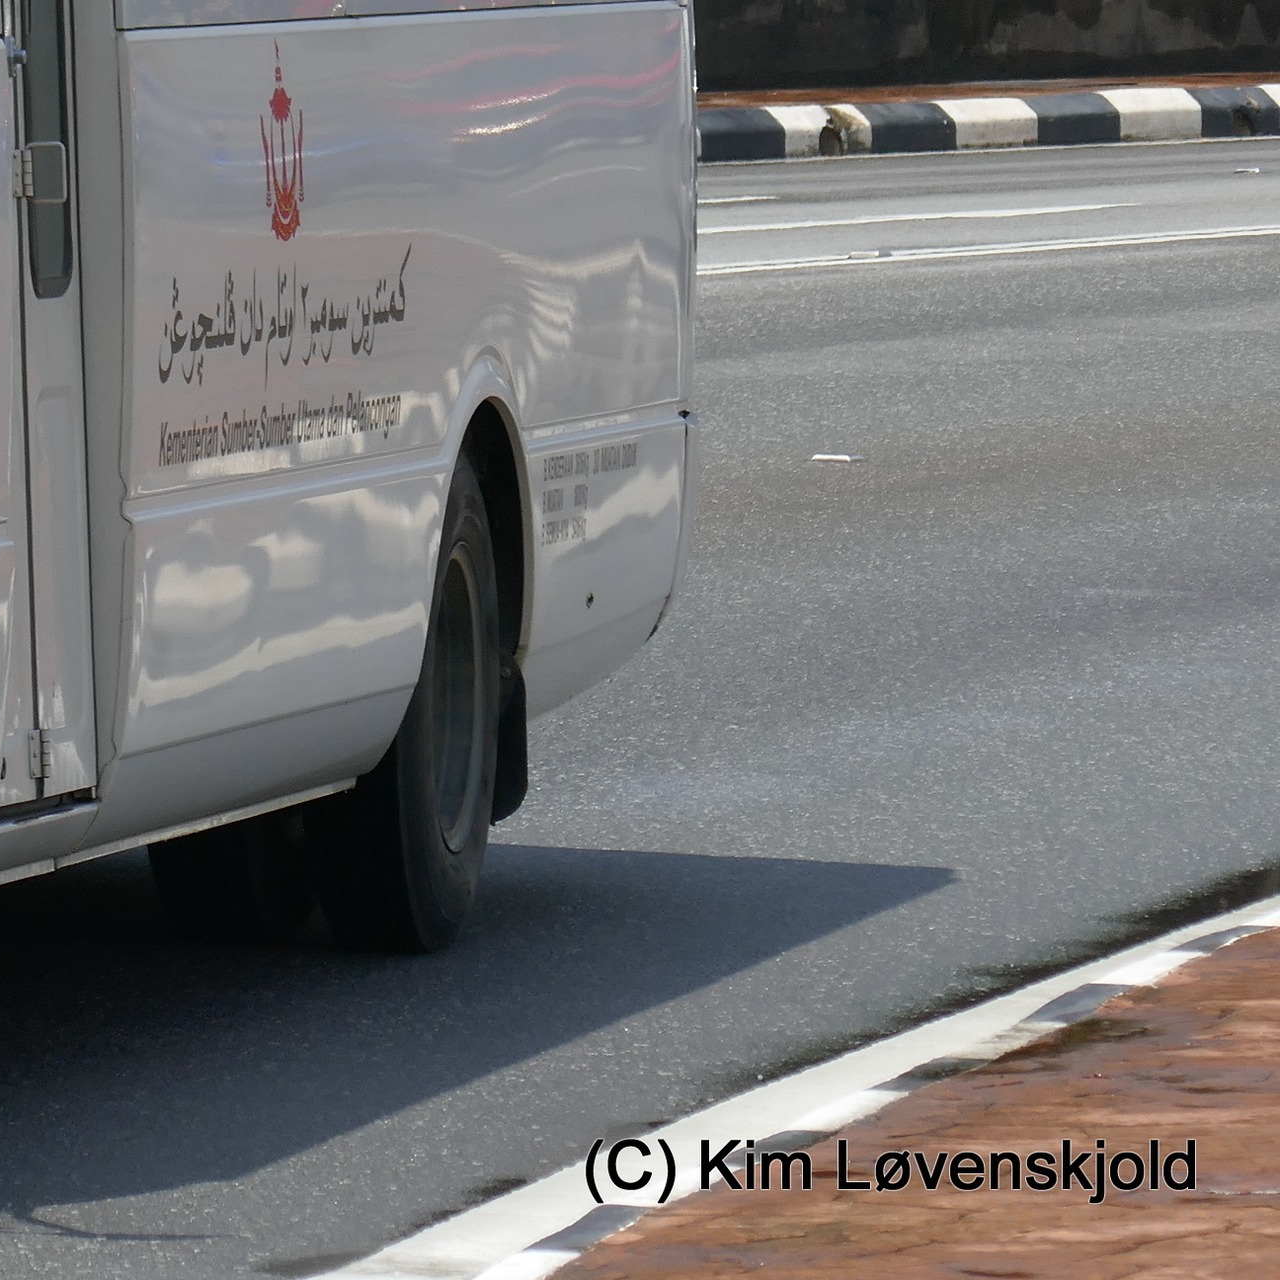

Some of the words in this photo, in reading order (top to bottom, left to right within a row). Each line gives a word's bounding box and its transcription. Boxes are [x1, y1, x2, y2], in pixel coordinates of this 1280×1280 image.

[159, 415, 219, 467] Kementerian
[297, 399, 325, 444] Utama
[327, 394, 344, 438] dan
[346, 390, 402, 440] Pelancongan
